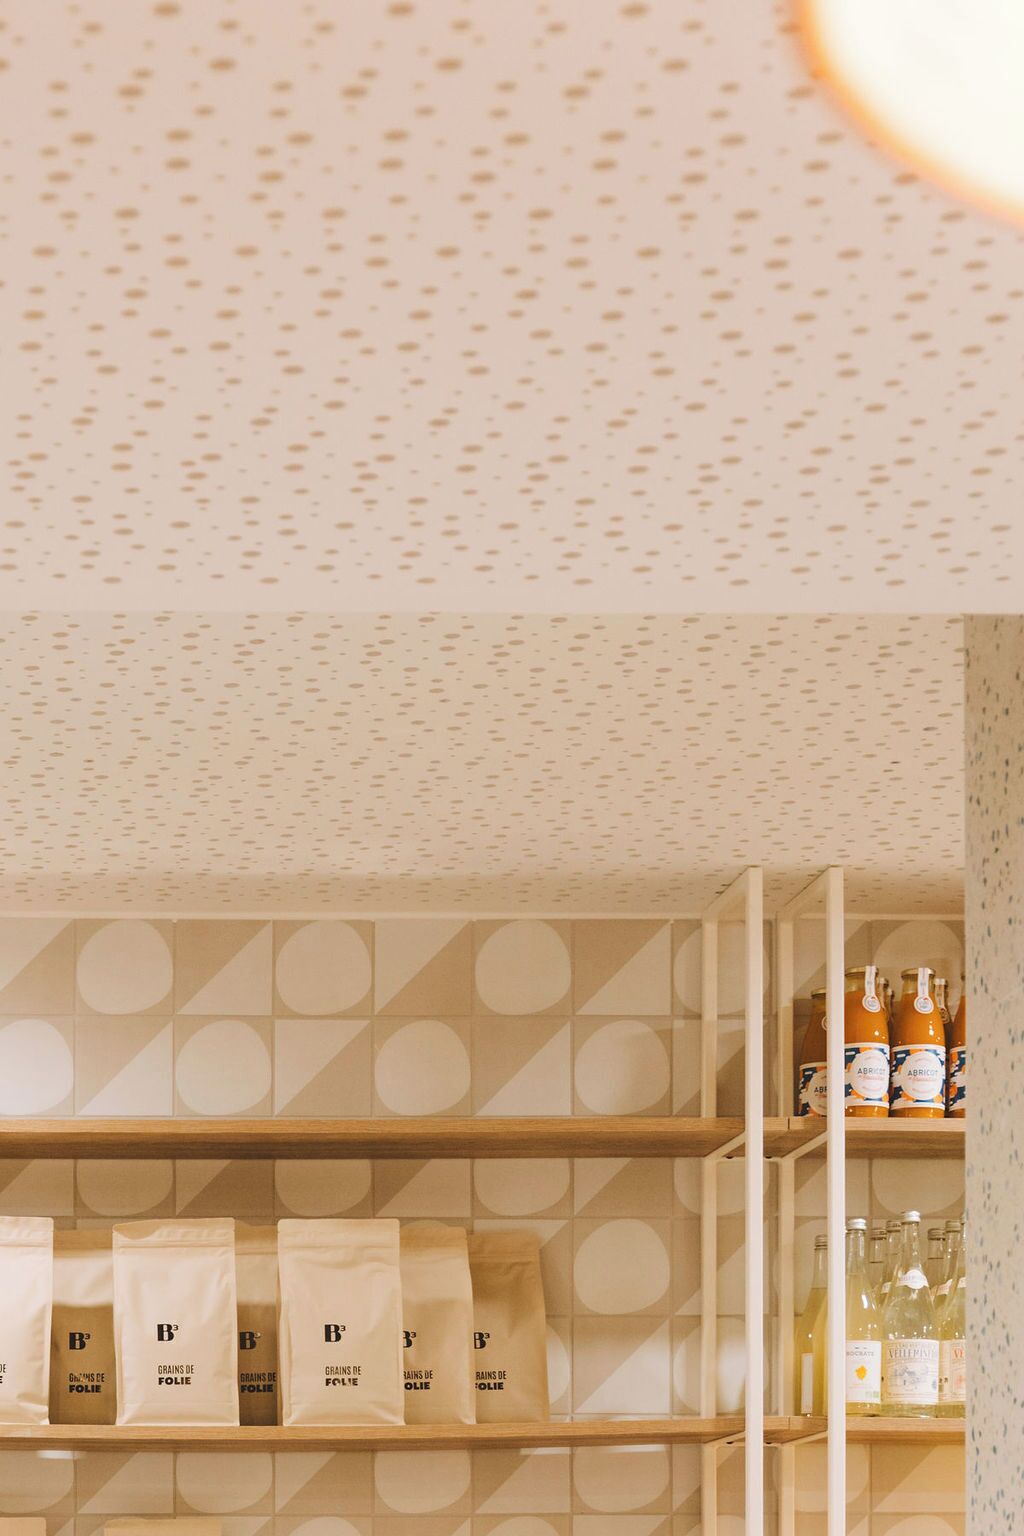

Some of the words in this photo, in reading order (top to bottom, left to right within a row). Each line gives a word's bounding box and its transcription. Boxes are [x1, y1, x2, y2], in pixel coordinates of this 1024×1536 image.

[857, 1067, 886, 1075] ABRICOT
[907, 1069, 938, 1077] ABRICOT
[158, 1365, 184, 1374] GRAINS
[186, 1365, 194, 1374] DE
[325, 1366, 351, 1376] GRAINS
[353, 1366, 361, 1375] DE
[69, 1373, 95, 1383] GRAINS
[96, 1373, 105, 1382] DE
[240, 1372, 266, 1382] GRAINS
[268, 1372, 276, 1382] DE
[403, 1370, 423, 1380] RAINS
[425, 1370, 433, 1379] DE
[476, 1371, 496, 1380] RAINS
[498, 1371, 506, 1380] DE
[158, 1377, 191, 1385] FOLIE
[326, 1378, 358, 1386] FOLIE
[69, 1385, 101, 1393] FOLIE
[240, 1384, 273, 1393] FOLIE
[404, 1382, 430, 1390] OLIE
